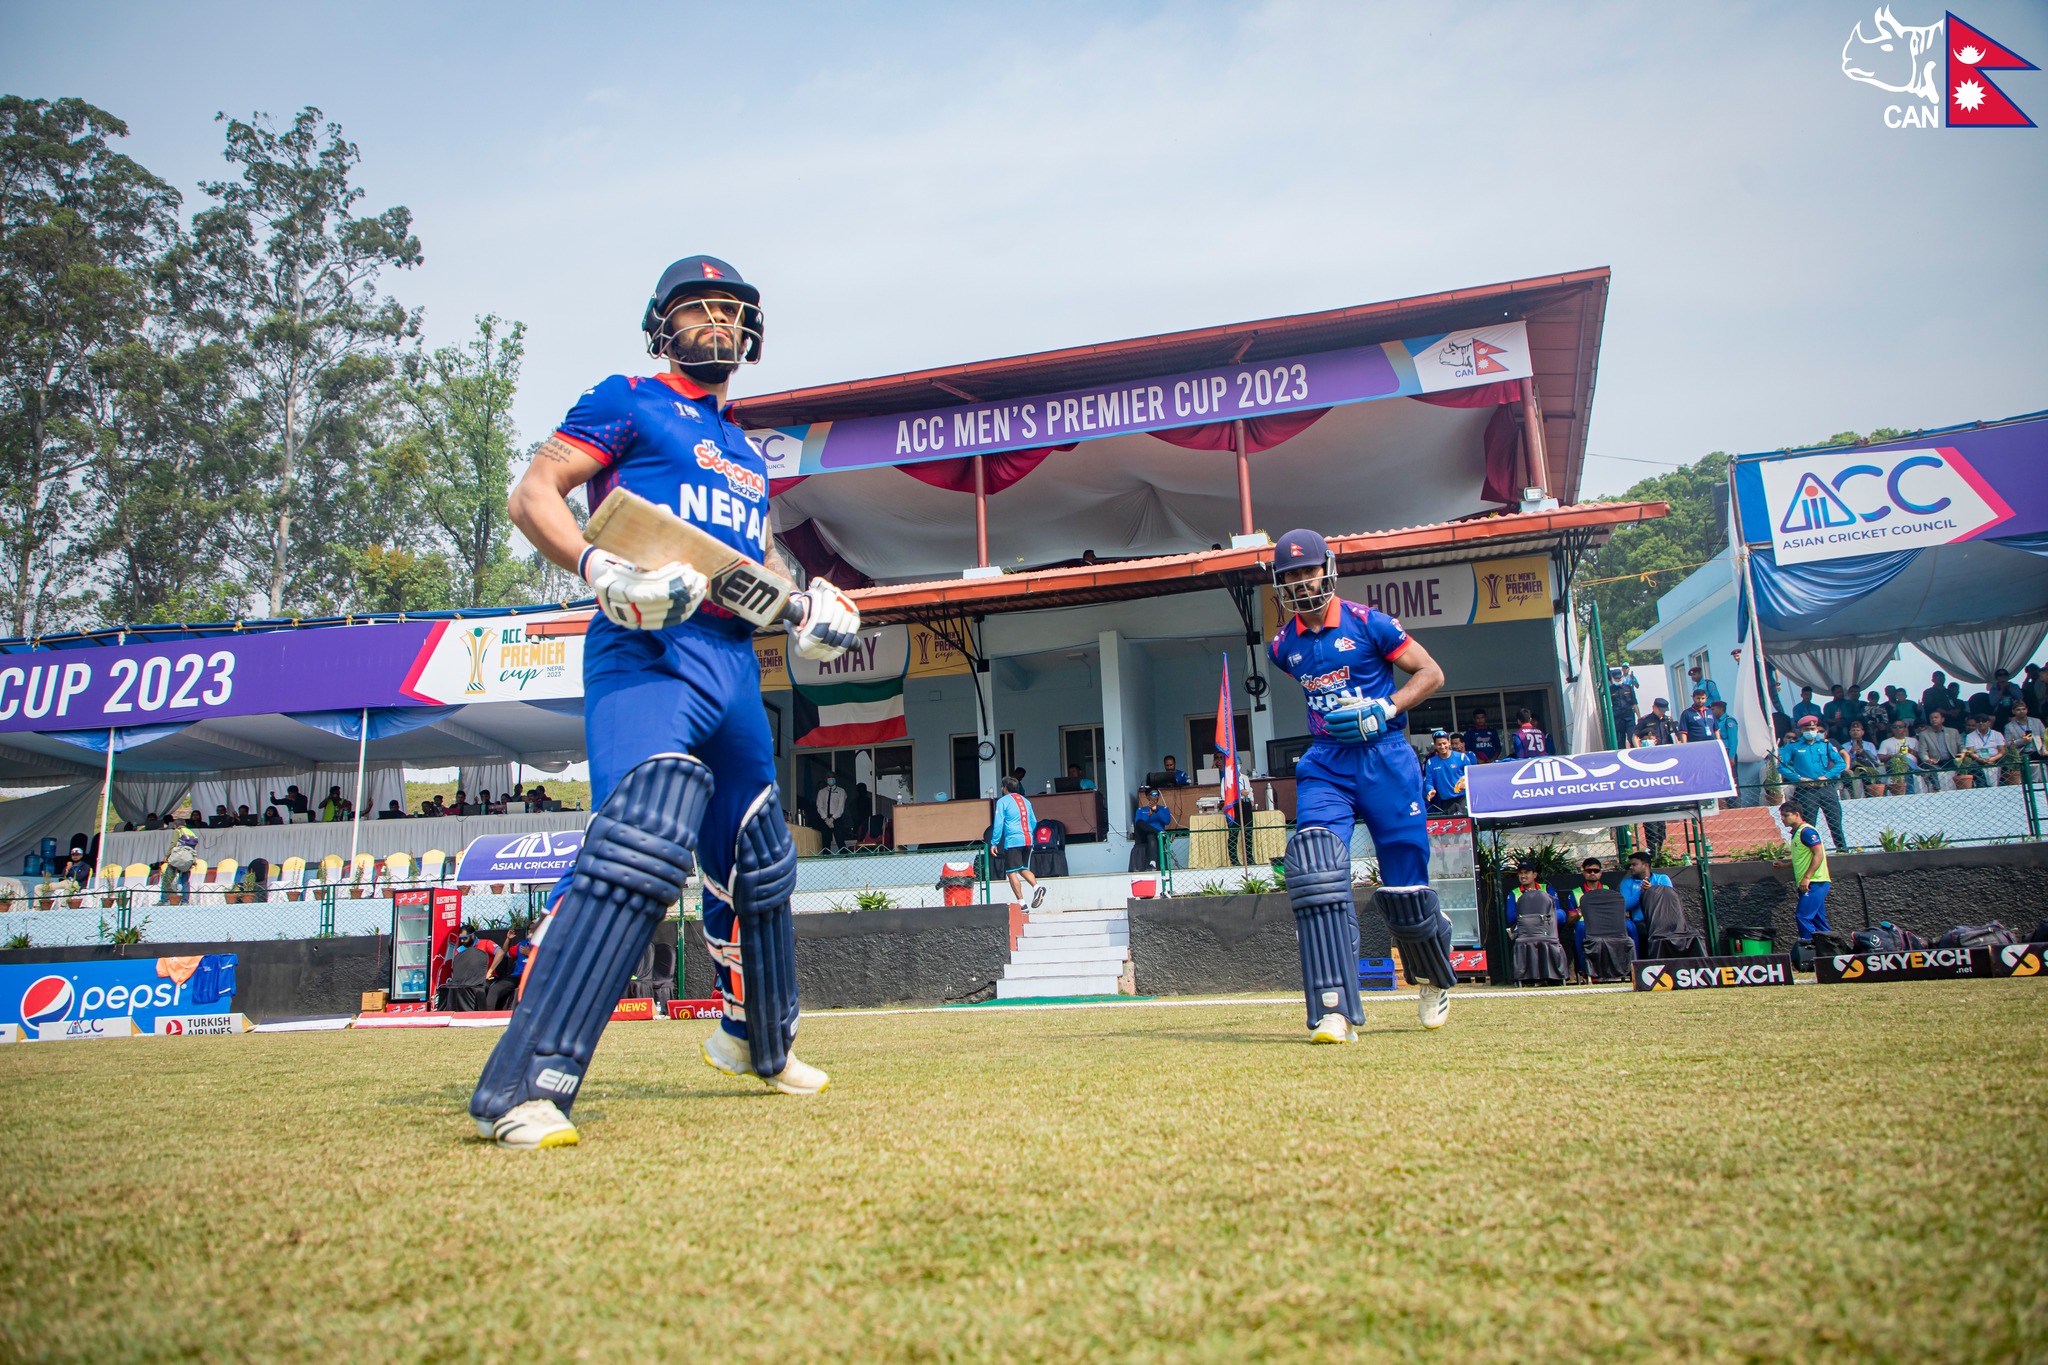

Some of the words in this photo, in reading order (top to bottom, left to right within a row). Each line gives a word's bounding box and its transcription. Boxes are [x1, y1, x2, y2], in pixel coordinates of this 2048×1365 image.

[1455, 368, 1474, 378] CAN
[896, 416, 945, 455] ACC
[954, 404, 1038, 448] MEN'S
[1046, 386, 1166, 436] PREMIER
[1174, 376, 1228, 417] CUP
[1237, 363, 1309, 409] 2023
[695, 445, 765, 496] Second
[729, 479, 761, 501] Teacher
[1780, 456, 1952, 534] ACC
[1782, 535, 1825, 550] ASIAN
[1828, 527, 1888, 544] CRICKET
[1891, 518, 1957, 536] COUNCIL
[1366, 578, 1443, 619] HOME
[1505, 580, 1544, 595] PREMIER
[1507, 595, 1532, 606] cup
[502, 627, 522, 644] ACC
[500, 642, 566, 668] PREMIER
[759, 656, 783, 668] REMIER
[0, 663, 92, 721] CUP
[103, 650, 236, 714] 2023
[499, 668, 545, 691] cup
[1526, 733, 1545, 752] 25
[1512, 786, 1555, 800] ASIAN
[1557, 781, 1616, 796] CRICKET
[1618, 775, 1684, 790] COUNCIL
[490, 861, 523, 871] ASIAN
[524, 860, 568, 870] CRICKET
[1866, 948, 1972, 972] SKYEXCH
[1956, 966, 1973, 974] .net
[1676, 963, 1785, 988] SKYEXCH
[79, 983, 182, 1018] pepsi
[187, 1016, 231, 1028] TURKISH
